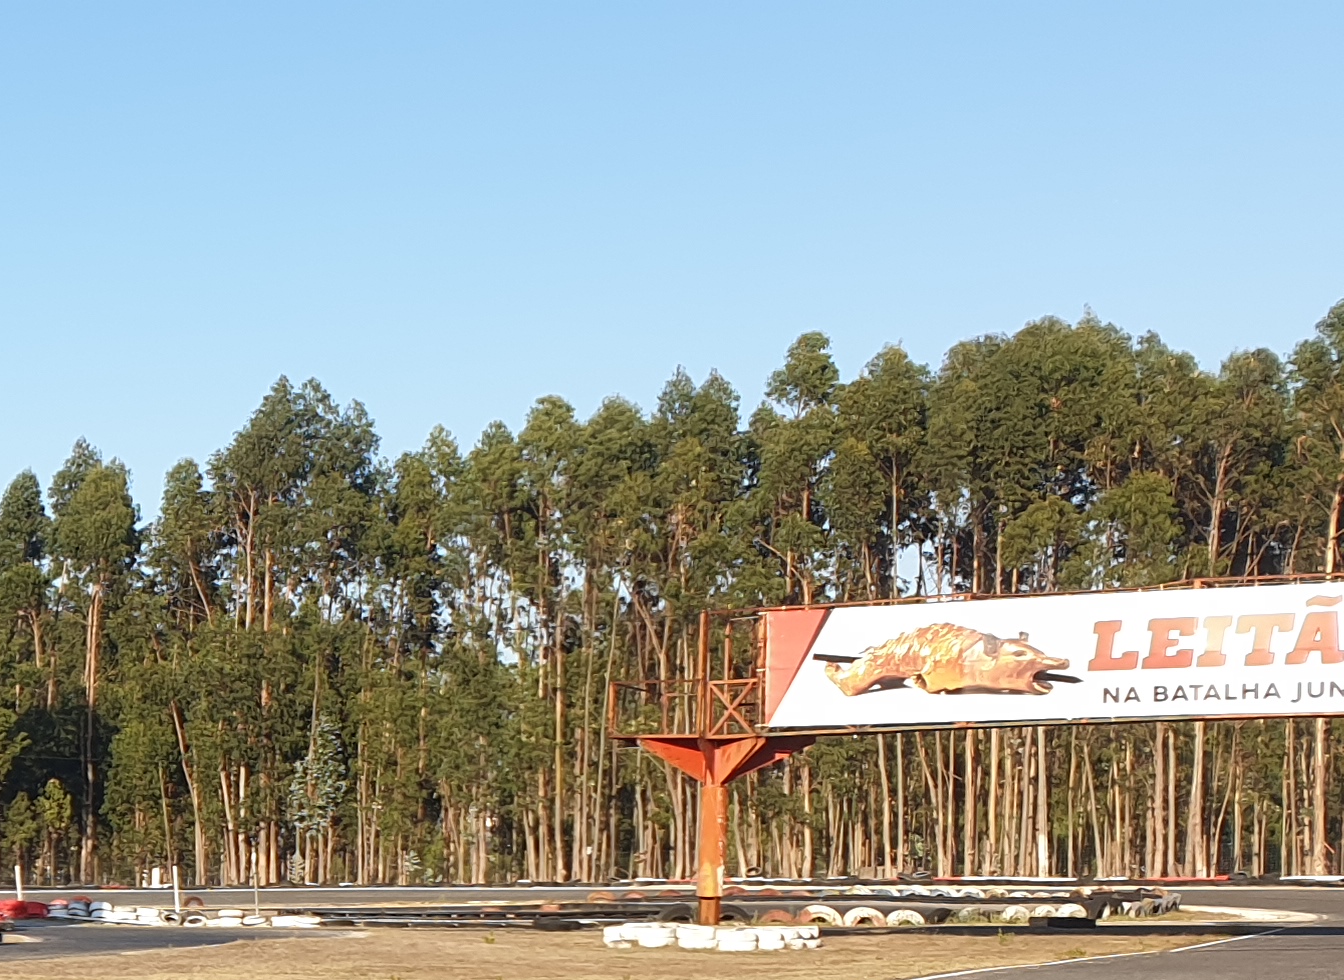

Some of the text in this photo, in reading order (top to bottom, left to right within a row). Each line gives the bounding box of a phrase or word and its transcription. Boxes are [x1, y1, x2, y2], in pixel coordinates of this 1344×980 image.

[1103, 680, 1344, 704] NA BATALHA JUN
